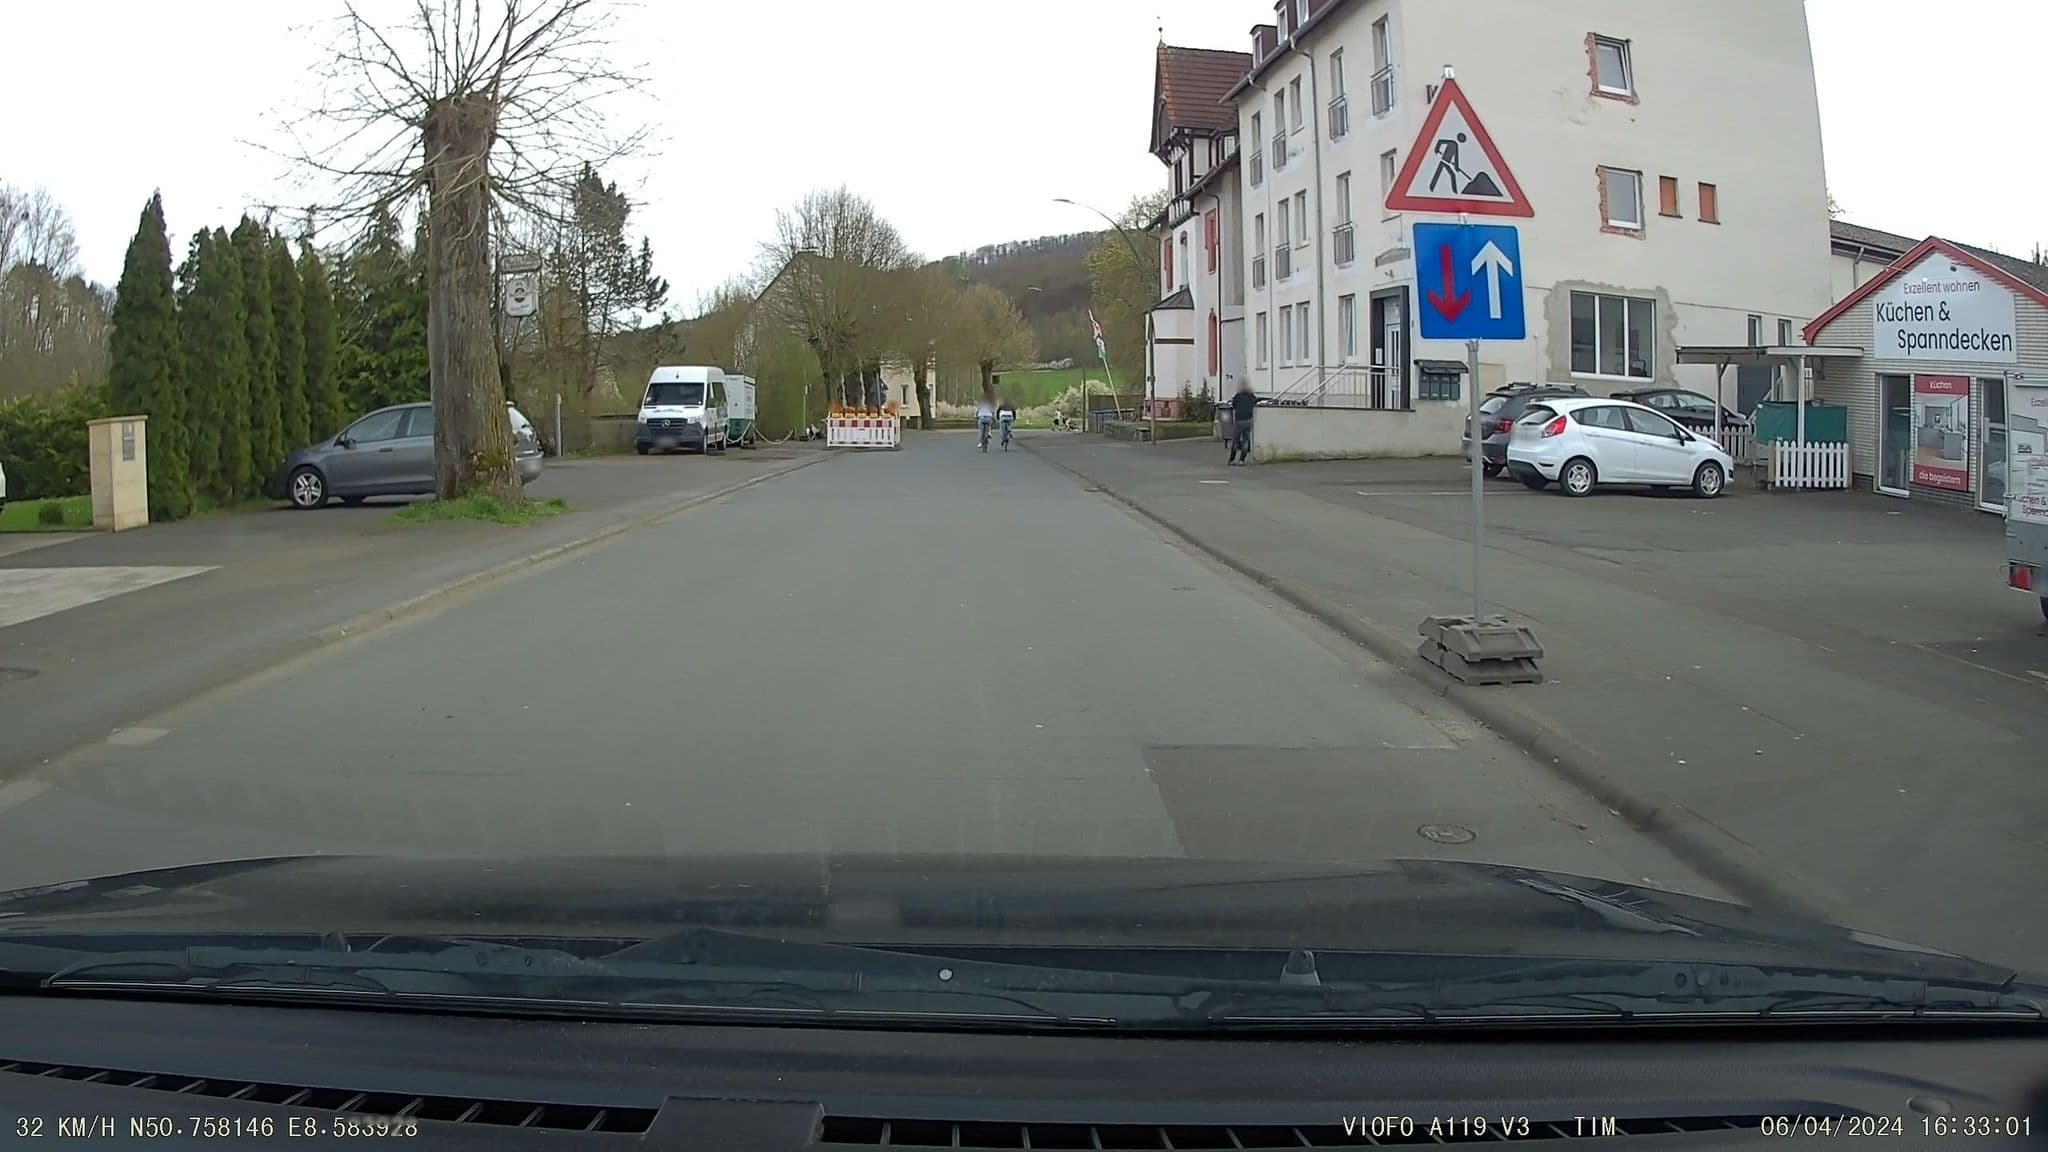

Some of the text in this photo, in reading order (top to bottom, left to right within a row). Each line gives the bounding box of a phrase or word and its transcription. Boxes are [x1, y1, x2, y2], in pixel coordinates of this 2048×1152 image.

[1903, 280, 1980, 295] Exzellent wohnen
[1876, 301, 1951, 322] Küchen &
[1897, 328, 2012, 356] Spanndecken
